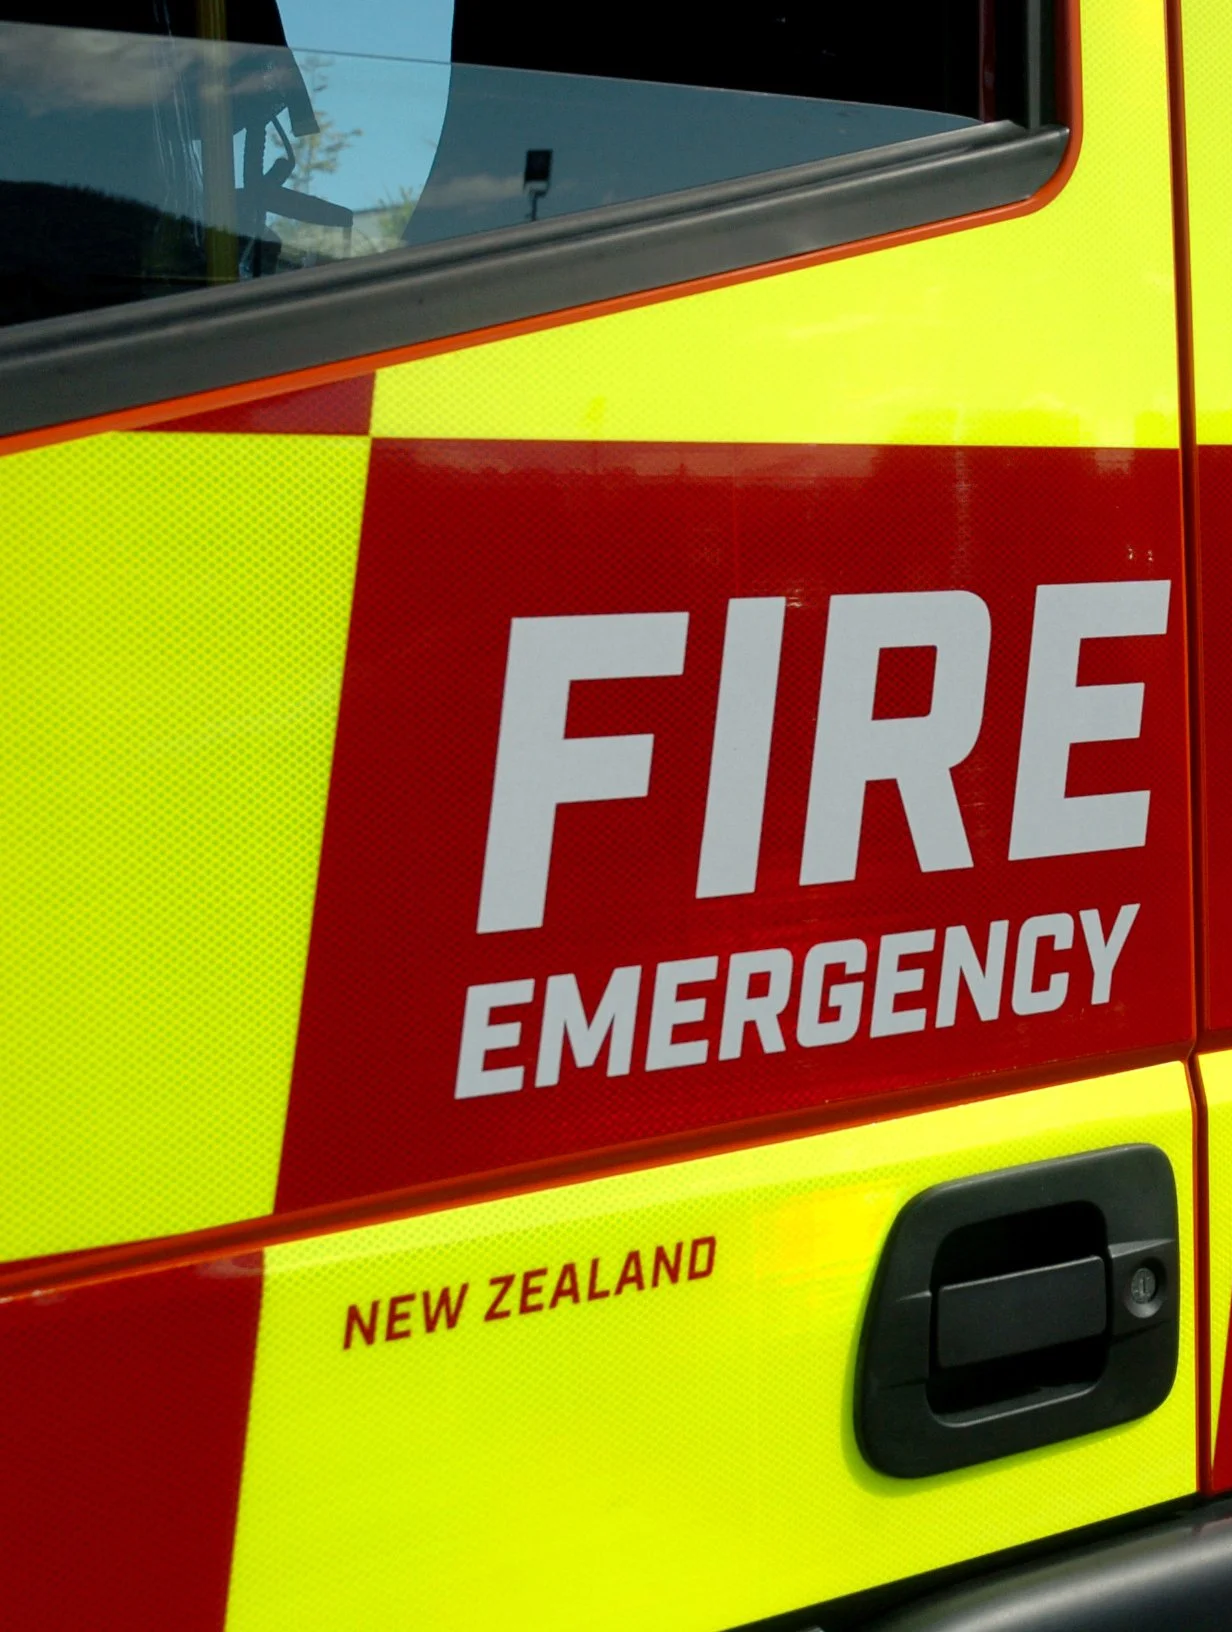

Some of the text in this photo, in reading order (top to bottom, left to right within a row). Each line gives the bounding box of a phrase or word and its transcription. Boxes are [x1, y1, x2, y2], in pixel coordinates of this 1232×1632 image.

[476, 579, 1171, 934] FIRE
[454, 903, 1141, 1101] EMERGENCY
[343, 1236, 717, 1350] NEW ZEALAND
